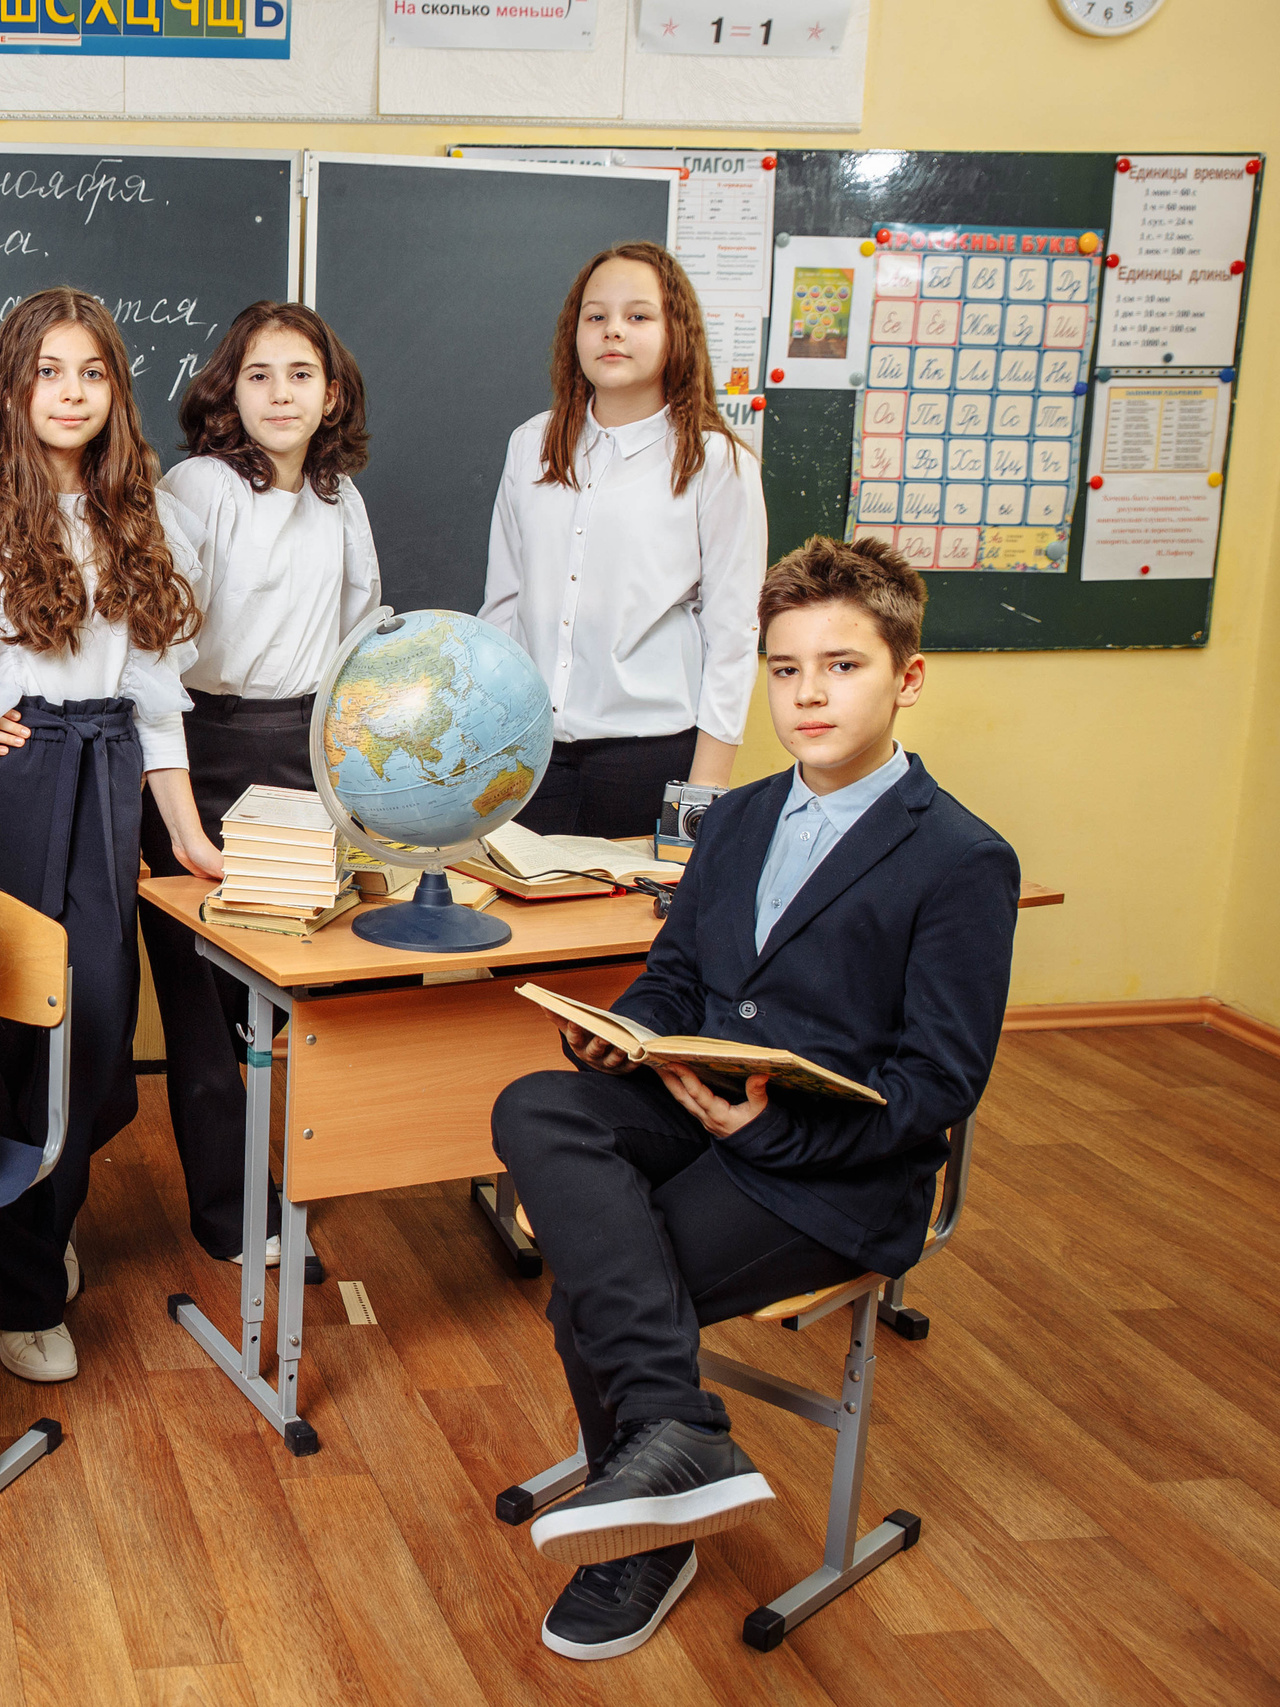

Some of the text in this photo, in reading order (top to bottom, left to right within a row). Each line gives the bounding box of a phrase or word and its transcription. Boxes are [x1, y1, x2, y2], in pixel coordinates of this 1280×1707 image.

[394, 1, 564, 18] На сколько меньше
[1085, 1, 1134, 20] 7 6 5
[683, 157, 745, 173] ГЛАГОЛ
[1128, 165, 1244, 184] Единицы времени
[1021, 235, 1080, 254] БУКВ
[972, 268, 998, 289] Вв
[1117, 266, 1182, 284] Единицы
[961, 313, 999, 336] Жж
[873, 402, 1069, 434] Оо Пп Рр Сс Тт
